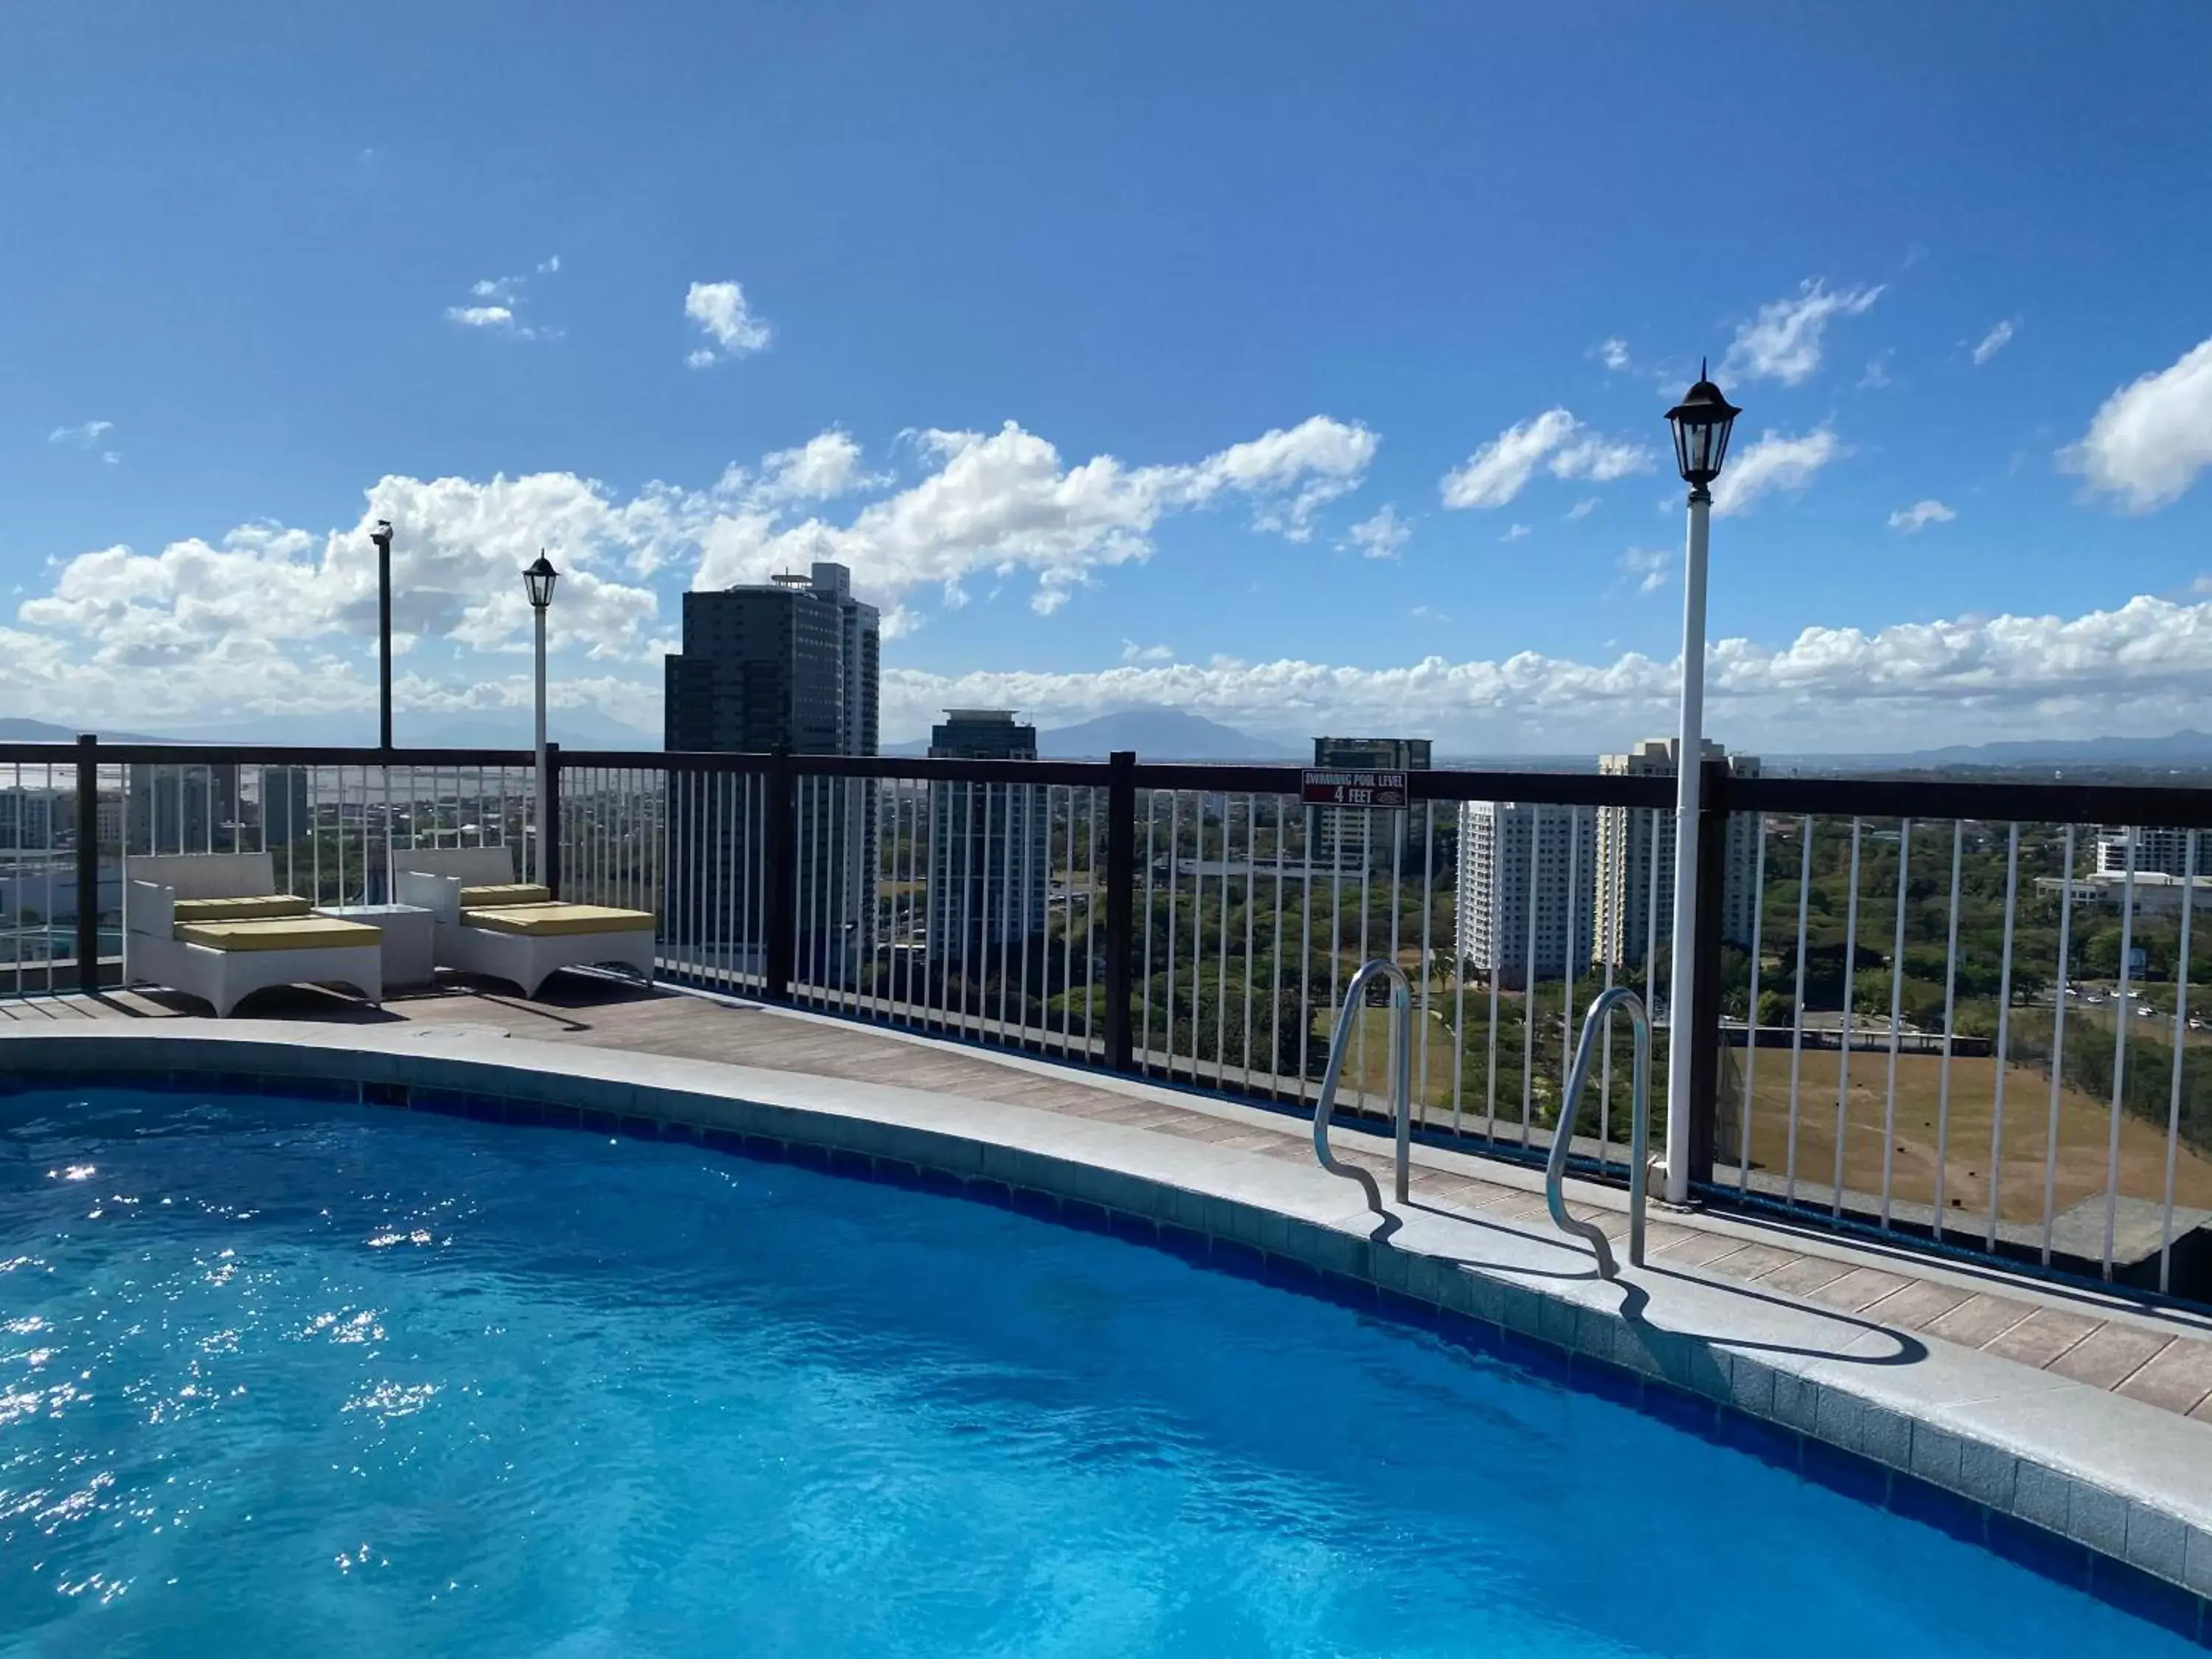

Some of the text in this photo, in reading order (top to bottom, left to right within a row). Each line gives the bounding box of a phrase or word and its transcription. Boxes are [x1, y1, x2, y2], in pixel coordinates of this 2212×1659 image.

[1305, 772, 1402, 787] SWIMMING POOL LEVEL
[1334, 786, 1344, 803] 4
[1349, 788, 1373, 803] FEET
